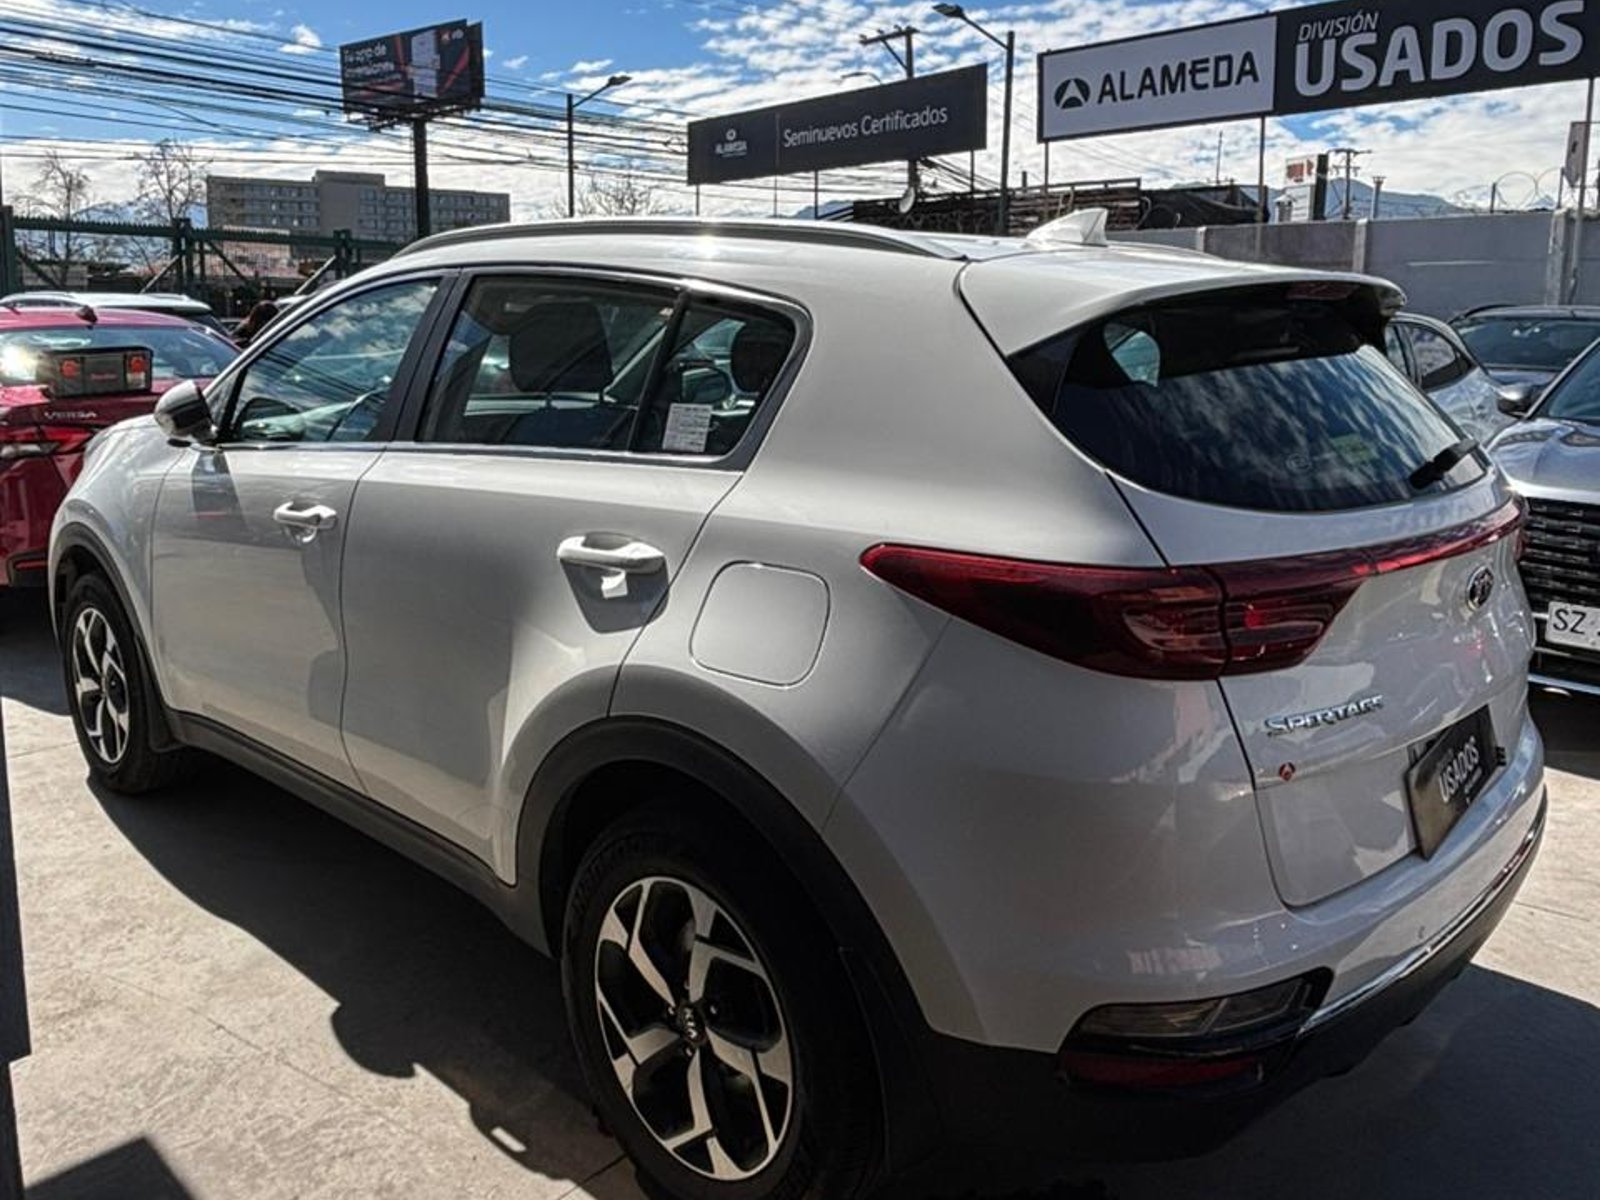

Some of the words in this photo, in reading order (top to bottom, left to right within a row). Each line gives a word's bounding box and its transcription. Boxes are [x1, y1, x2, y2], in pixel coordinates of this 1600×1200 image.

[1295, 0, 1584, 96] USADOS
[1299, 10, 1379, 41] DIVISIÓN
[1097, 51, 1259, 104] ALAMEDA
[783, 123, 858, 148] Seminuevos
[861, 105, 948, 137] Certificados
[1439, 736, 1480, 803] USADOS
